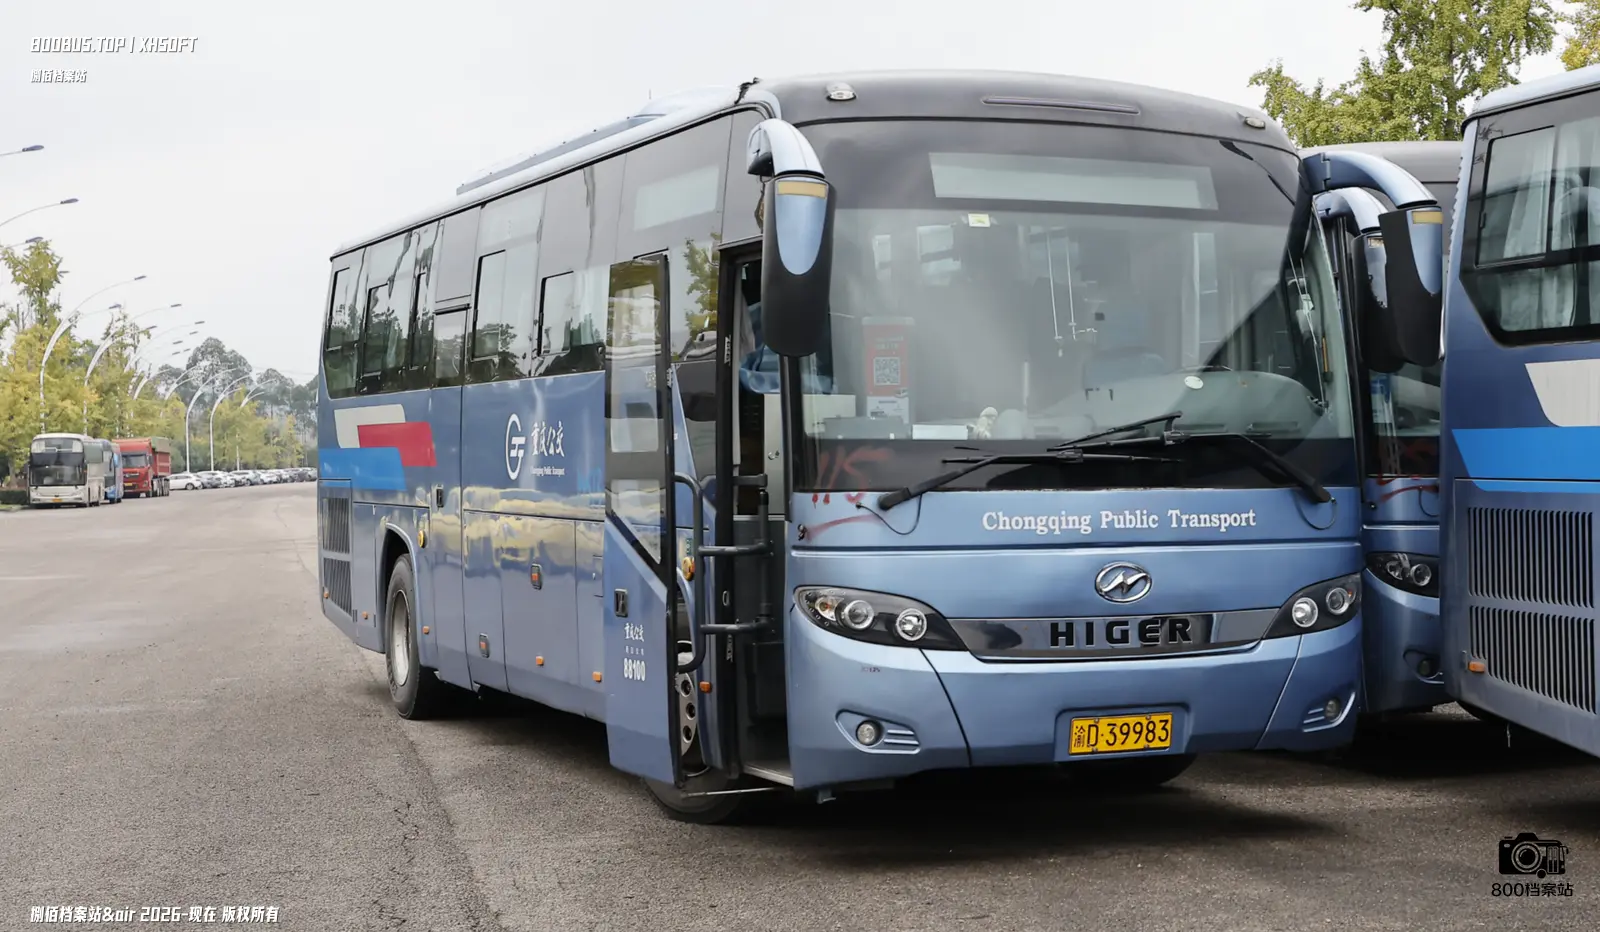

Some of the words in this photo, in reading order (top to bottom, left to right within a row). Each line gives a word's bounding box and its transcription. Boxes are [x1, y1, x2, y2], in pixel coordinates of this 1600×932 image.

[531, 420, 565, 457] 重庆公交
[982, 511, 1092, 534] Chongqing
[1100, 510, 1159, 529] Public
[1168, 509, 1256, 532] Transport
[1050, 618, 1193, 648] HIGER
[624, 657, 646, 681] 88100
